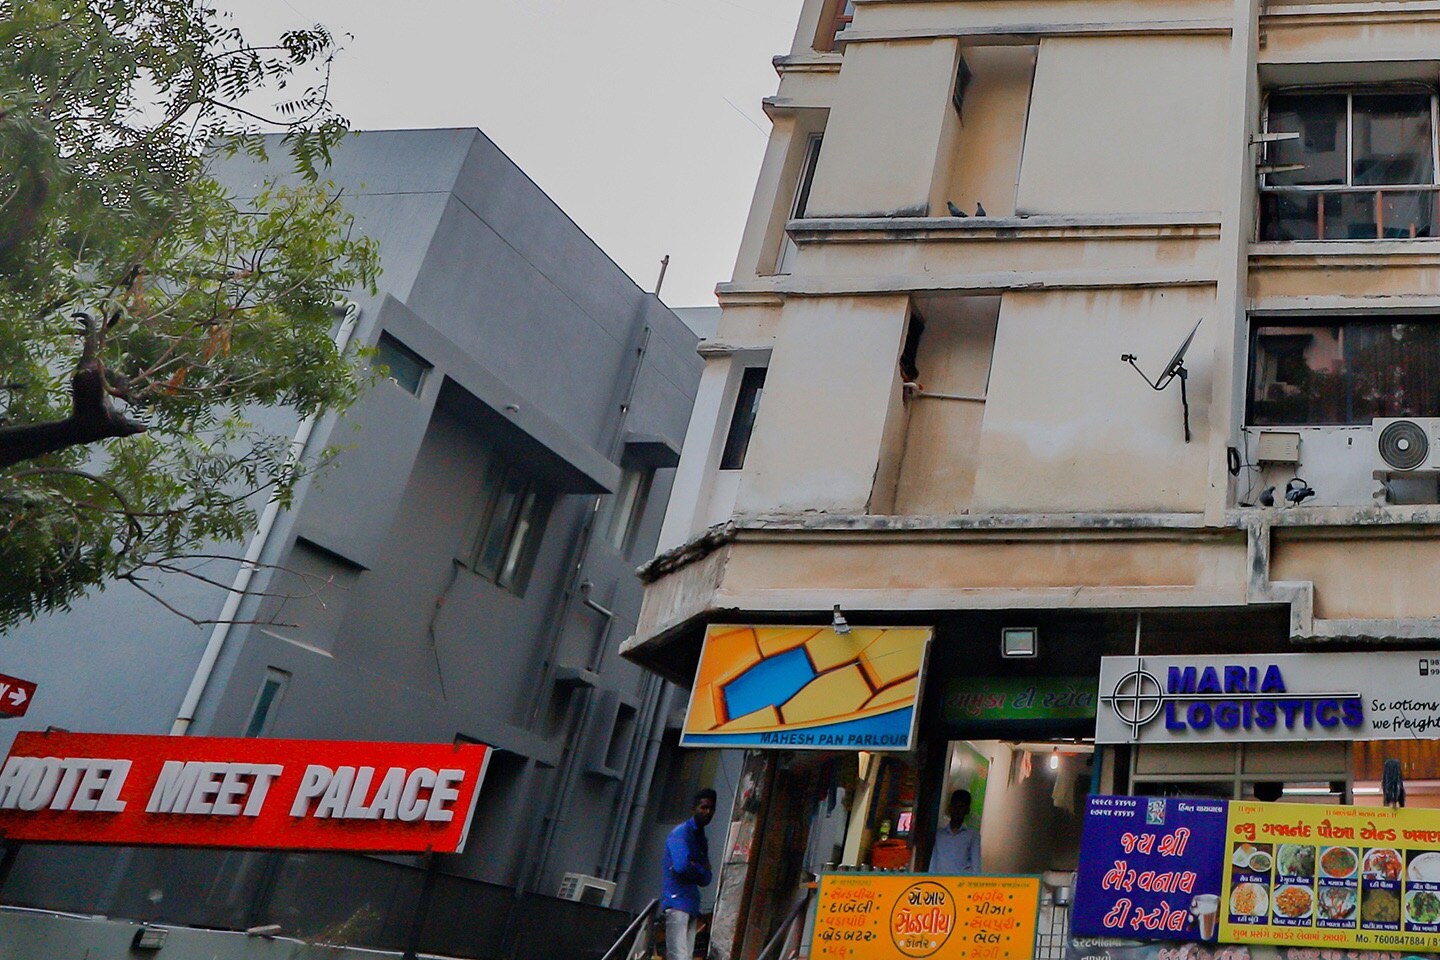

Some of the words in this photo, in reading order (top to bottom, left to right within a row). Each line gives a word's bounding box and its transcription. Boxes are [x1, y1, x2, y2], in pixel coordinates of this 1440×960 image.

[1167, 664, 1287, 694] MARIA
[1165, 699, 1365, 730] LOGISTICS
[1372, 720, 1391, 729] we
[760, 732, 815, 745] MAHESH
[818, 734, 844, 745] PAN
[847, 734, 909, 746] PARLOUR
[0, 756, 132, 812] HOTEL
[145, 760, 284, 817] MEET
[289, 764, 466, 822] PALACE
[1121, 832, 1156, 855] જય
[1157, 827, 1191, 856] શ્રી
[1234, 823, 1256, 841] ન્યુ
[1360, 821, 1397, 841] એન્ડ
[1102, 859, 1197, 894] ભૈરવનાથ
[830, 899, 873, 913] દાબેલી
[975, 901, 1006, 915] પીઝા
[1103, 898, 1132, 929] ટી
[1130, 900, 1188, 932] સ્ટોલ
[1356, 934, 1371, 943] Mo.
[1374, 935, 1425, 946] 7600847884
